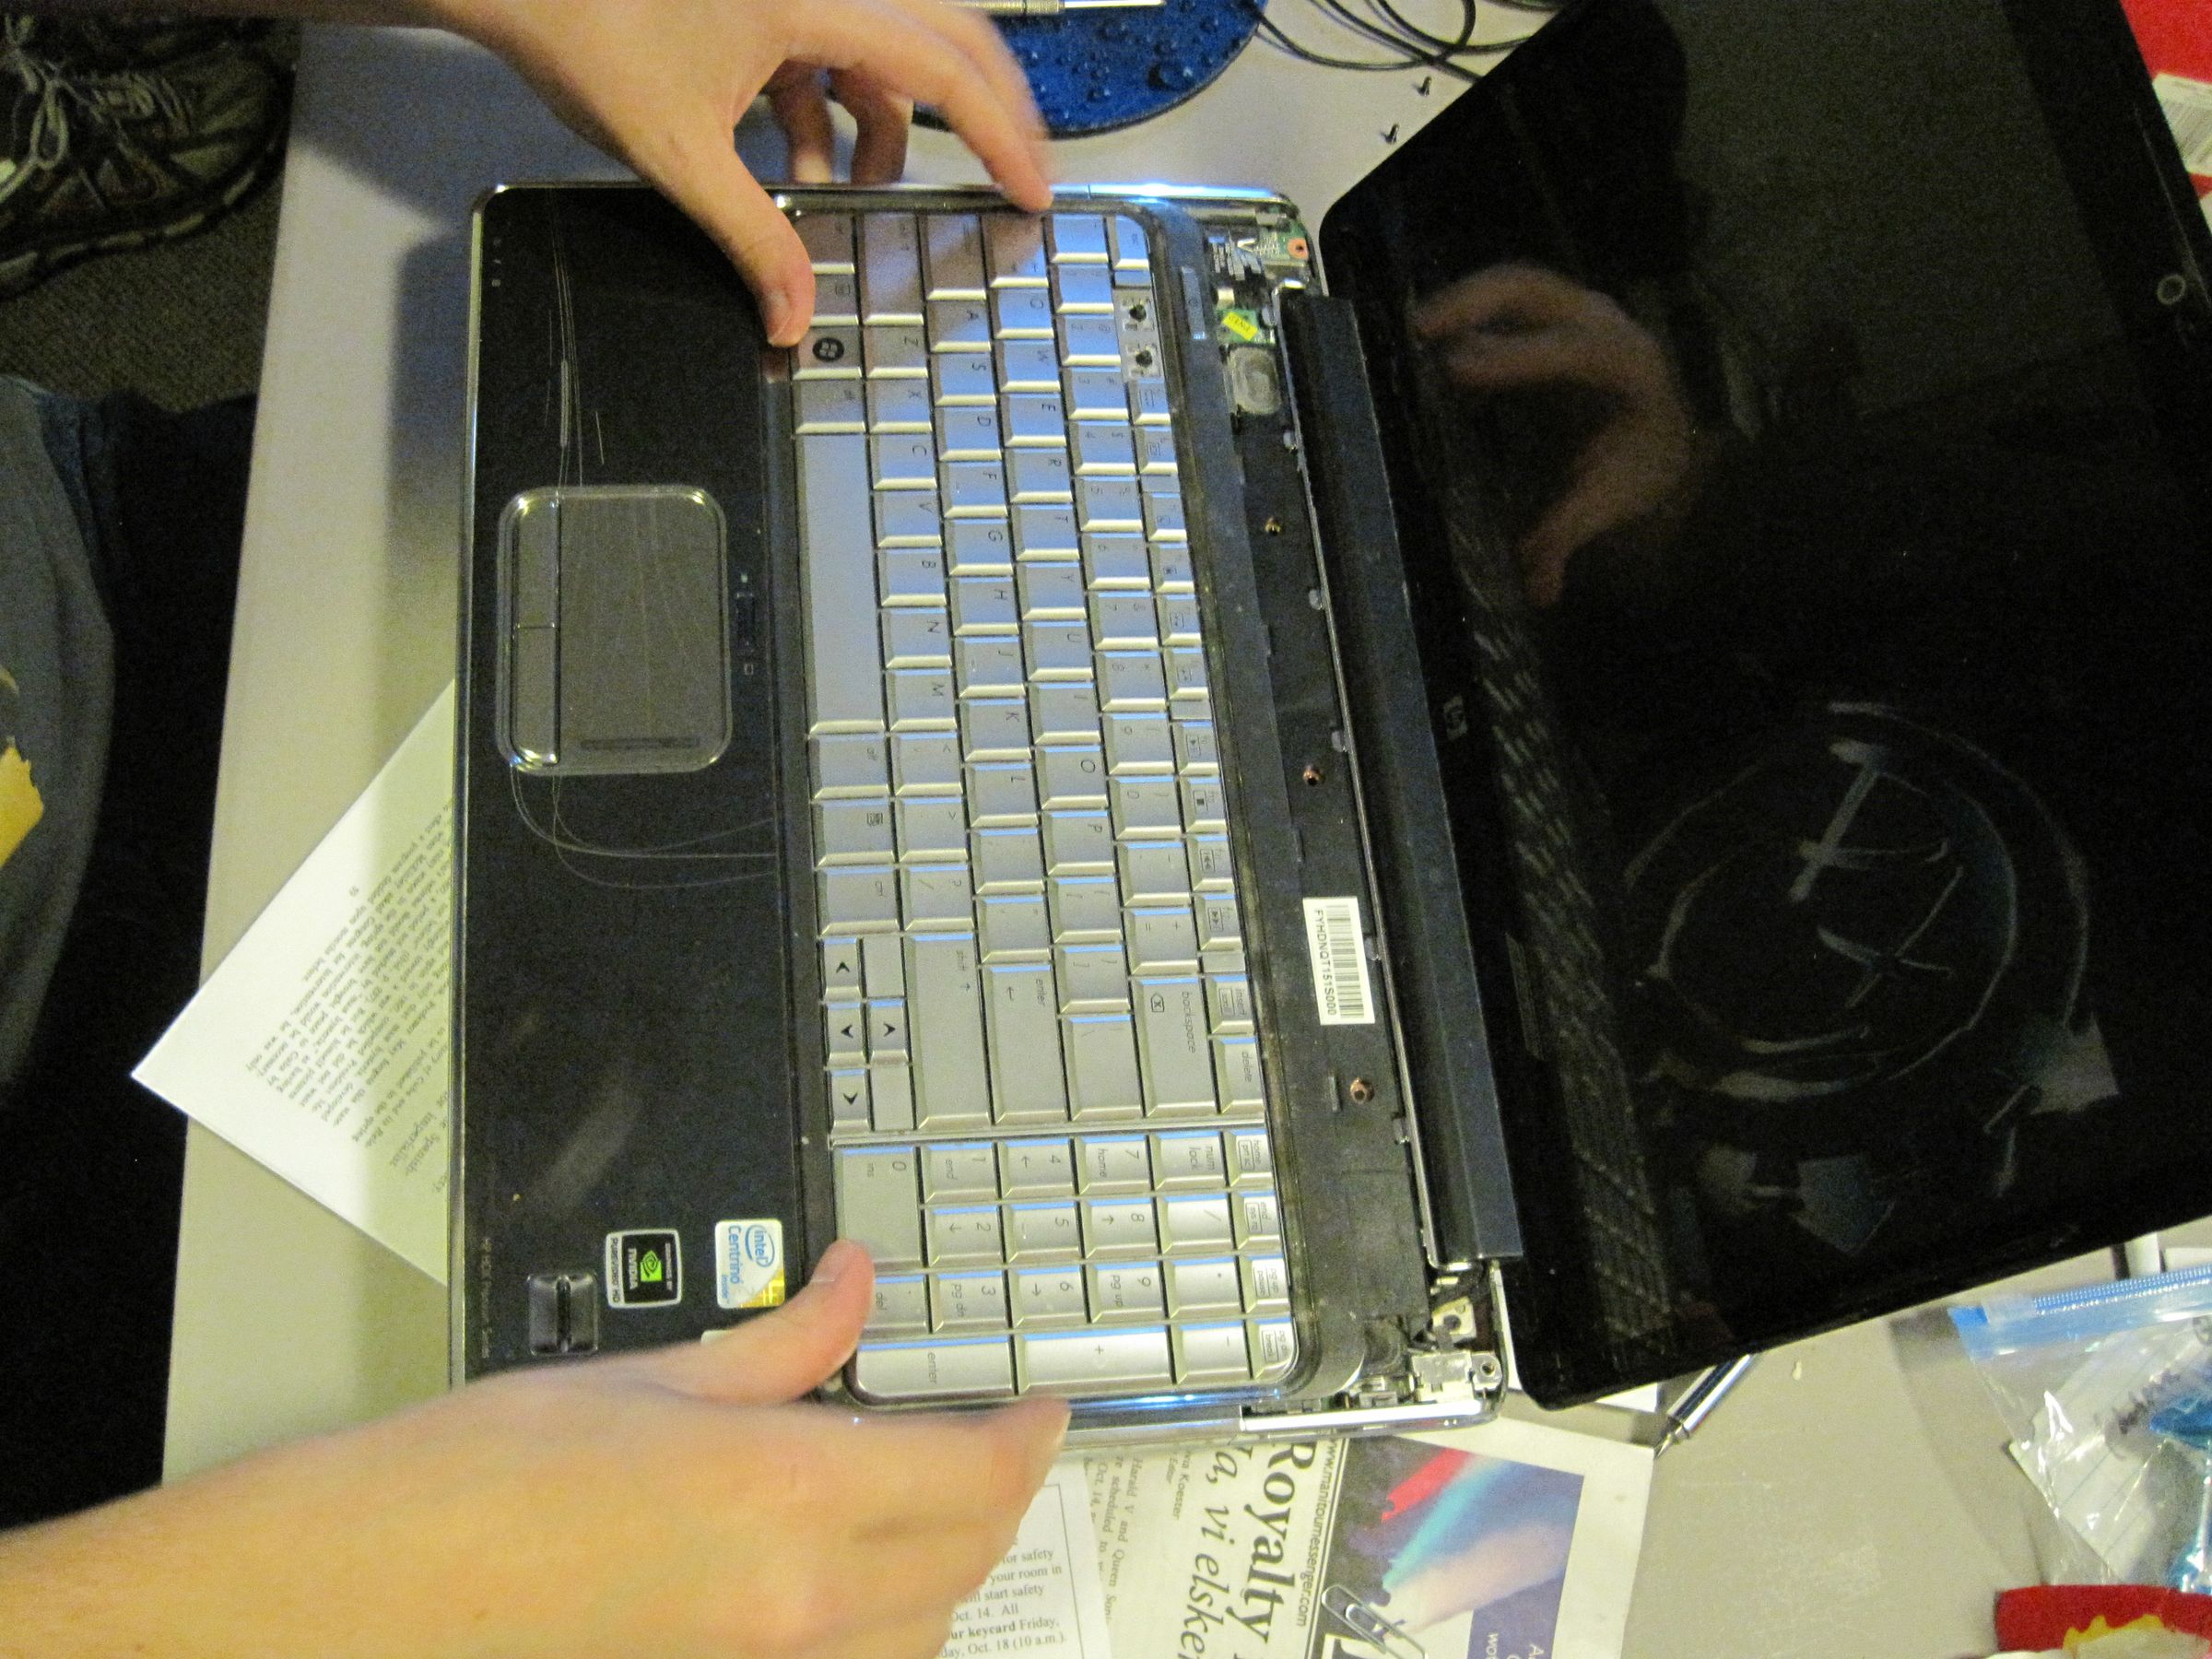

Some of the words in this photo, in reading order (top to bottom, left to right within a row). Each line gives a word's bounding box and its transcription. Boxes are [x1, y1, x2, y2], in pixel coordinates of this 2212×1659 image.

[967, 310, 981, 321] A
[904, 336, 918, 347] Z
[1037, 349, 1050, 364] W
[971, 363, 986, 371] S
[907, 389, 923, 399] X
[1041, 403, 1056, 412] E
[977, 416, 992, 427] D
[912, 445, 927, 456] C
[1048, 457, 1062, 466] R
[982, 471, 996, 480] F
[919, 501, 933, 512] V
[1054, 514, 1068, 524] T
[988, 530, 1003, 543] G
[922, 559, 936, 569] B
[1060, 573, 1075, 583] Y
[994, 589, 1007, 601] H
[926, 619, 941, 633] N
[1067, 632, 1082, 644] U
[931, 682, 945, 697] M
[1005, 712, 1020, 723] K
[1080, 759, 1096, 772] O
[1088, 823, 1102, 832] P
[1035, 979, 1048, 1007] enter
[1181, 991, 1198, 1053] backspace
[1241, 1052, 1256, 1082] delete
[1050, 1155, 1062, 1164] 4
[1125, 1148, 1140, 1159] 7
[1188, 1147, 1202, 1171] lock
[1206, 1146, 1216, 1171] num
[891, 1160, 908, 1171] 0
[945, 1159, 958, 1180] end
[1097, 1148, 1109, 1178] home
[1130, 1213, 1145, 1223] 8
[1260, 1202, 1271, 1221] end
[975, 1222, 991, 1232] 2
[1054, 1218, 1069, 1227] 5
[754, 1230, 768, 1263] intel
[728, 1225, 742, 1284] Centrino
[721, 1275, 729, 1299] inside
[1059, 1282, 1074, 1291] 6
[1111, 1275, 1123, 1290] pg
[1136, 1277, 1151, 1288] 9
[612, 1289, 620, 1303] HD
[951, 1283, 964, 1300] pg
[981, 1286, 996, 1296] 3
[875, 1292, 888, 1311] del
[1113, 1294, 1125, 1308] up
[955, 1303, 967, 1317] dn
[927, 1352, 940, 1384] enter
[1095, 1463, 1109, 1486] Oct.
[1126, 1458, 1143, 1497] Harald
[1166, 1457, 1178, 1484] Editor
[1090, 1490, 1101, 1507] 14,
[1172, 1474, 1189, 1520] Koester
[1102, 1476, 1121, 1533] scheduled
[1124, 1505, 1135, 1515] V
[1117, 1521, 1129, 1542] and
[1201, 1506, 1235, 1545] vi
[1099, 1541, 1109, 1553] to
[1227, 1442, 1316, 1644] Royalty
[1022, 1549, 1053, 1562] safety
[1109, 1548, 1125, 1587] Queen
[989, 1572, 1014, 1585] your
[1018, 1569, 1047, 1579] room
[1052, 1565, 1062, 1574] in
[984, 1589, 1007, 1601] start
[1012, 1585, 1044, 1596] safety
[978, 1607, 994, 1618] 14.
[1002, 1604, 1018, 1616] All
[968, 1622, 1015, 1639] keycard
[1019, 1618, 1059, 1630] Friday,
[968, 1643, 991, 1653] Oct.
[997, 1640, 1009, 1650] 18
[1013, 1636, 1031, 1650] (10
